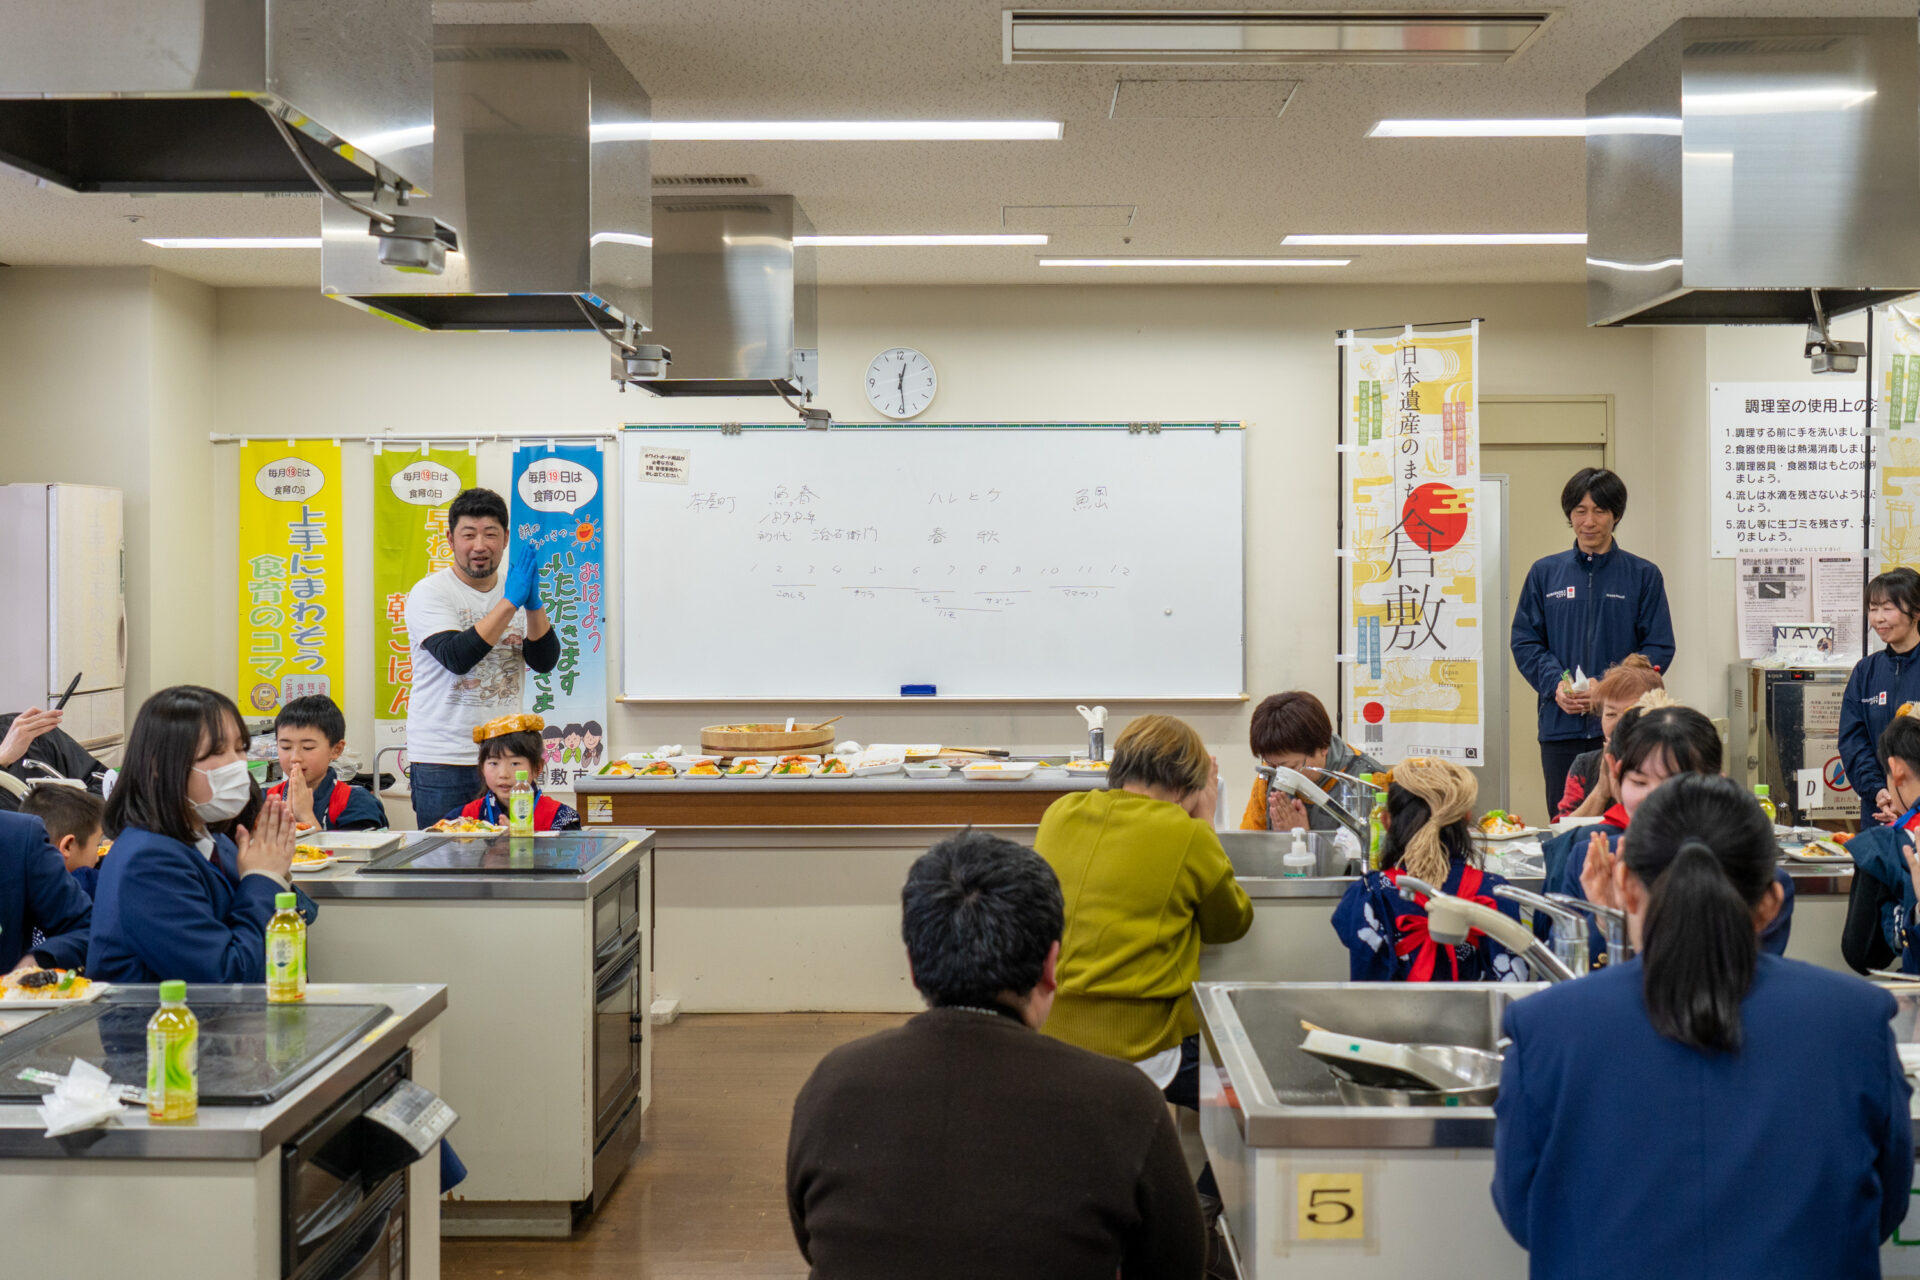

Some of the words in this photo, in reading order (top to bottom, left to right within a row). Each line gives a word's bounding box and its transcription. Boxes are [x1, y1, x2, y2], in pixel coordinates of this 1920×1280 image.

[897, 351, 904, 361] 12
[869, 378, 876, 388] 9
[927, 377, 933, 387] 3
[1400, 345, 1421, 501] 日本遺産のまち
[403, 469, 449, 481] 毎月19日は
[528, 469, 583, 483] 毎月19日は
[1736, 474, 1781, 484] ましょう。
[275, 485, 305, 495] 食育の日
[409, 488, 443, 499] 食育の日
[533, 490, 577, 502] 食育の日
[1737, 502, 1771, 513] しょう。
[976, 529, 1000, 544] 秋
[1737, 531, 1793, 542] りましょう。
[1380, 508, 1447, 653] 倉敷
[288, 504, 327, 671] 上手にまわそう
[579, 562, 601, 653] おはよう
[249, 553, 286, 679] 食育のコマ
[549, 551, 582, 697] いただきます
[532, 562, 556, 714] ごちさま
[1778, 627, 1832, 640] NAVY
[1806, 780, 1816, 797] D
[1307, 1189, 1355, 1225] 5
